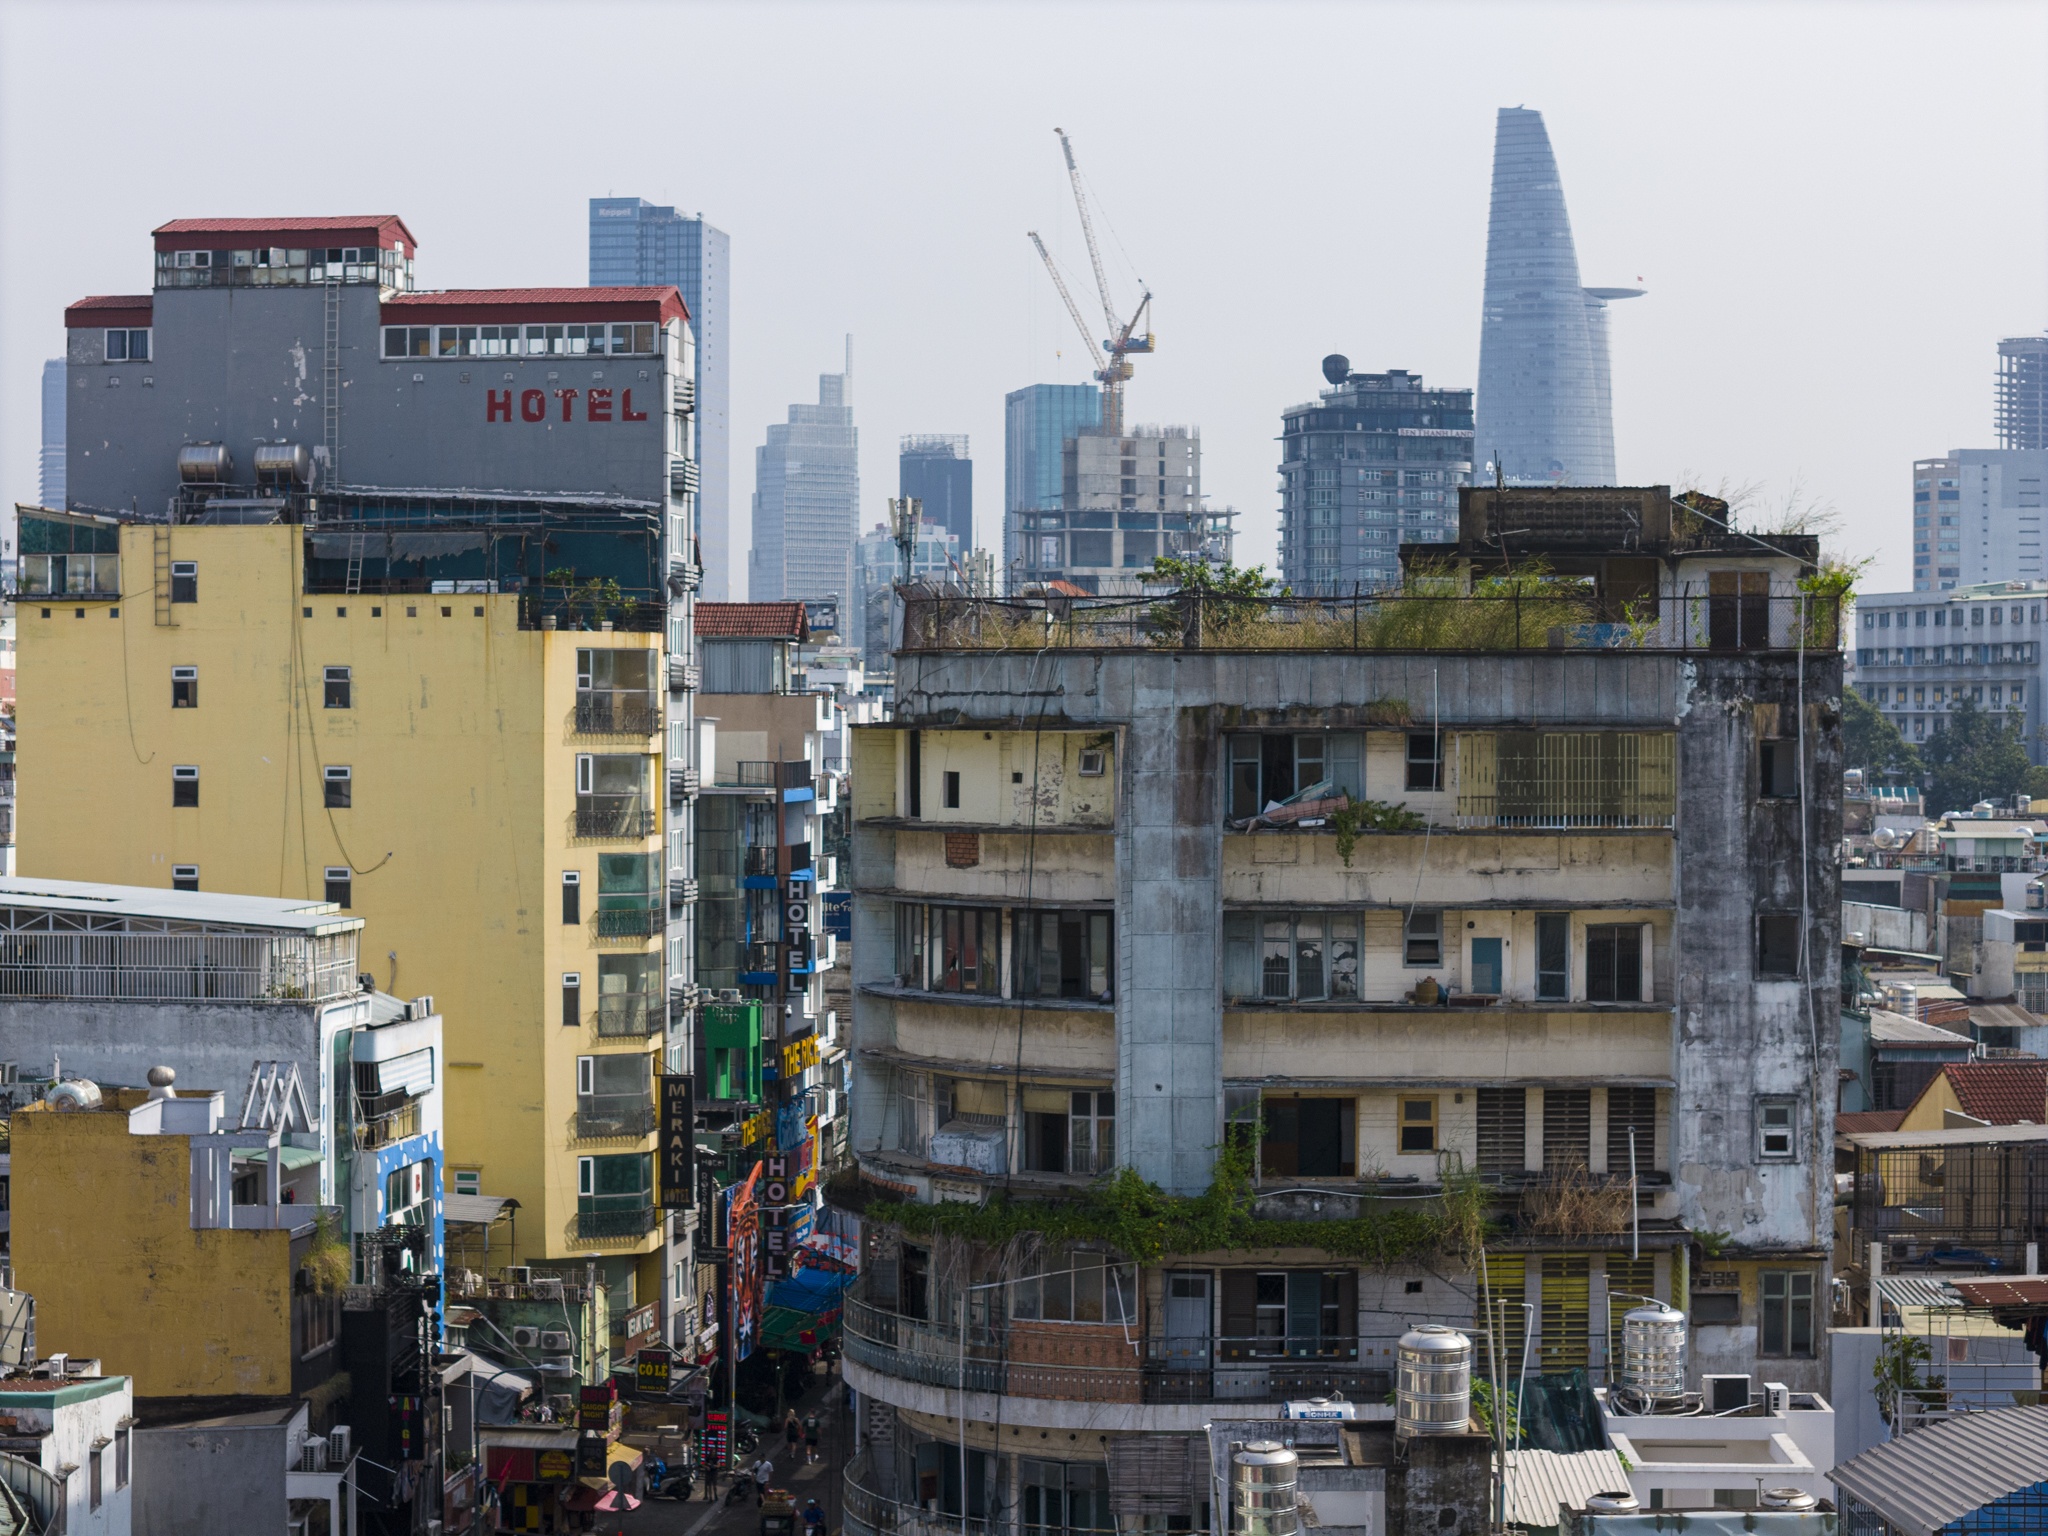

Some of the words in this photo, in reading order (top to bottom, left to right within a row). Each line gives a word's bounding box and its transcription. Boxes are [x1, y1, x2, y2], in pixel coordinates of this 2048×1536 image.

[599, 208, 631, 217] Keppel
[486, 388, 647, 423] HOTEL
[788, 881, 804, 992] HOTEL
[783, 1042, 801, 1079] THE
[801, 1033, 820, 1071] RICE
[668, 1083, 686, 1184] MERAKI
[742, 1118, 756, 1148] THE
[701, 1158, 725, 1167] Hotel
[663, 1188, 690, 1204] HOTEL
[700, 1171, 709, 1245] ROSABELLA
[767, 1158, 786, 1276] HOTEL
[639, 1361, 654, 1376] CÔ
[655, 1362, 668, 1379] LỆ
[581, 1403, 608, 1411] SAIGON
